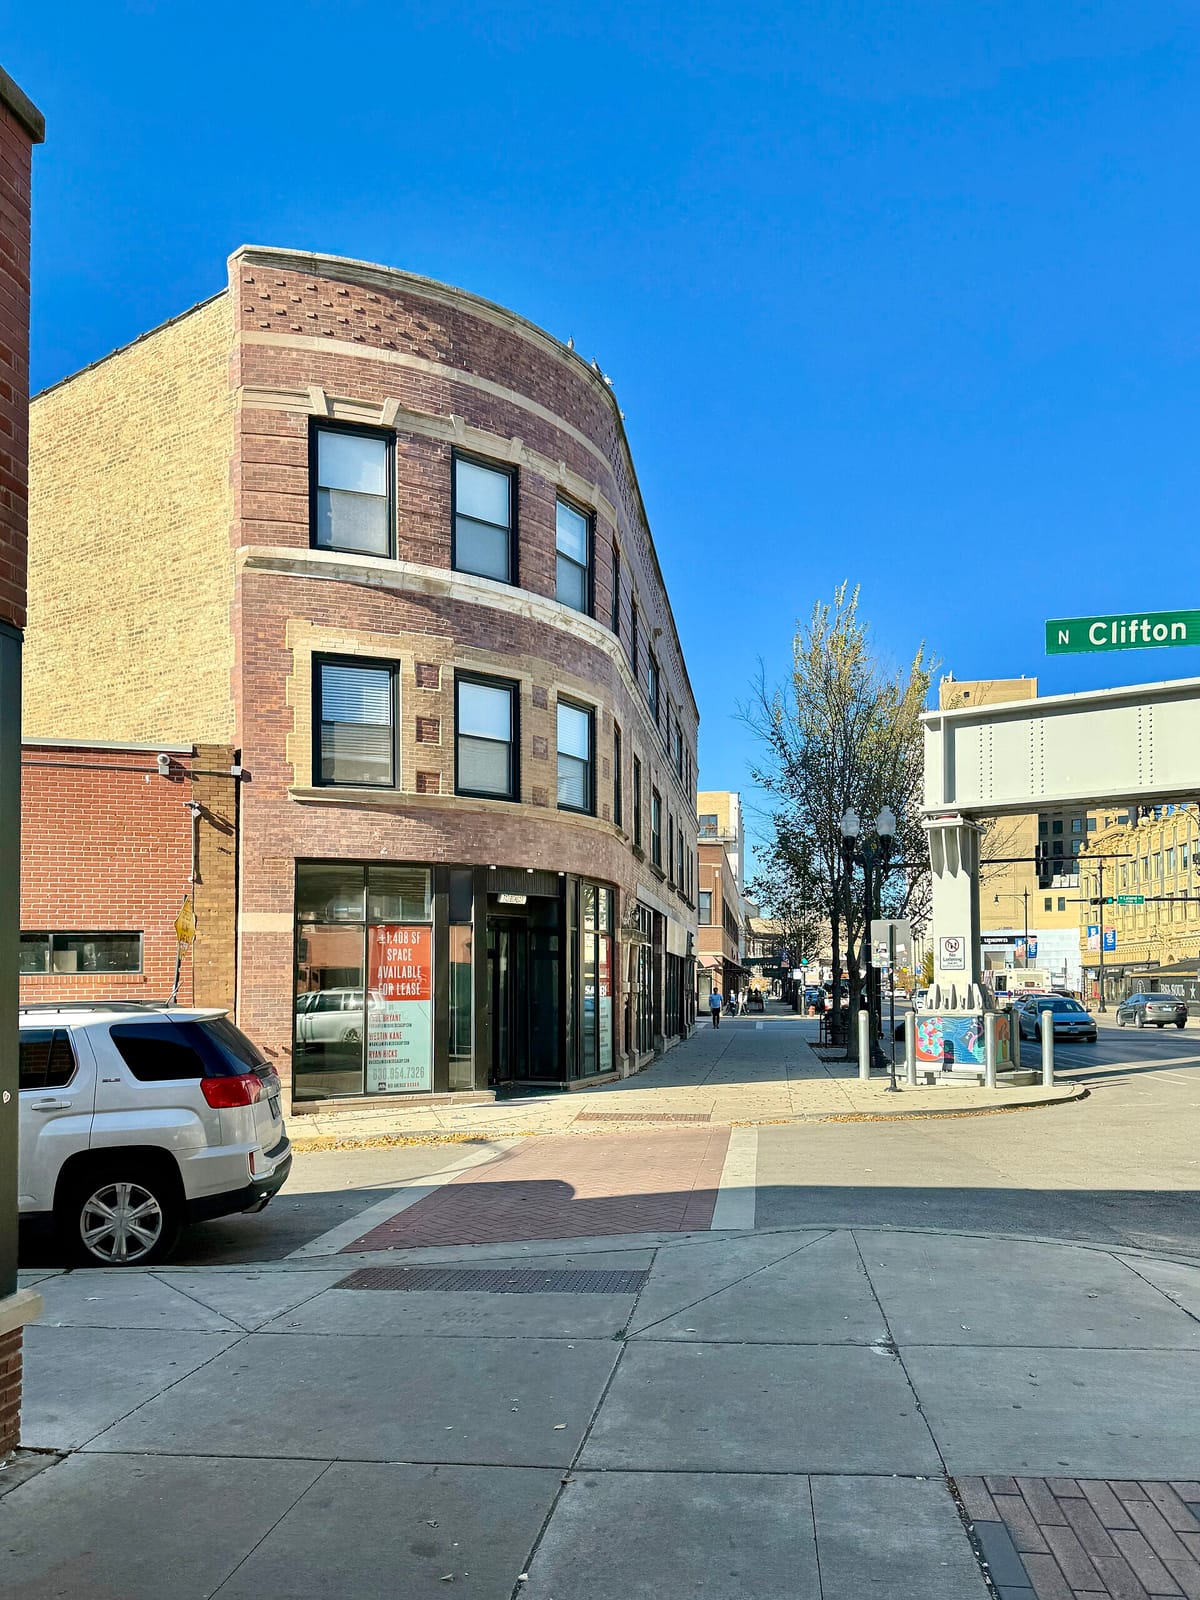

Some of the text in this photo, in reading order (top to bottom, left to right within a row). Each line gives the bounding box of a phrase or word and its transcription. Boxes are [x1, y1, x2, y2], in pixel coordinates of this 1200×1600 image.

[1058, 619, 1187, 646] N Clifton
[411, 931, 421, 945] SF
[386, 948, 413, 961] SPACE
[377, 965, 422, 979] AVAILABLE
[378, 982, 421, 996] FOR LEASE
